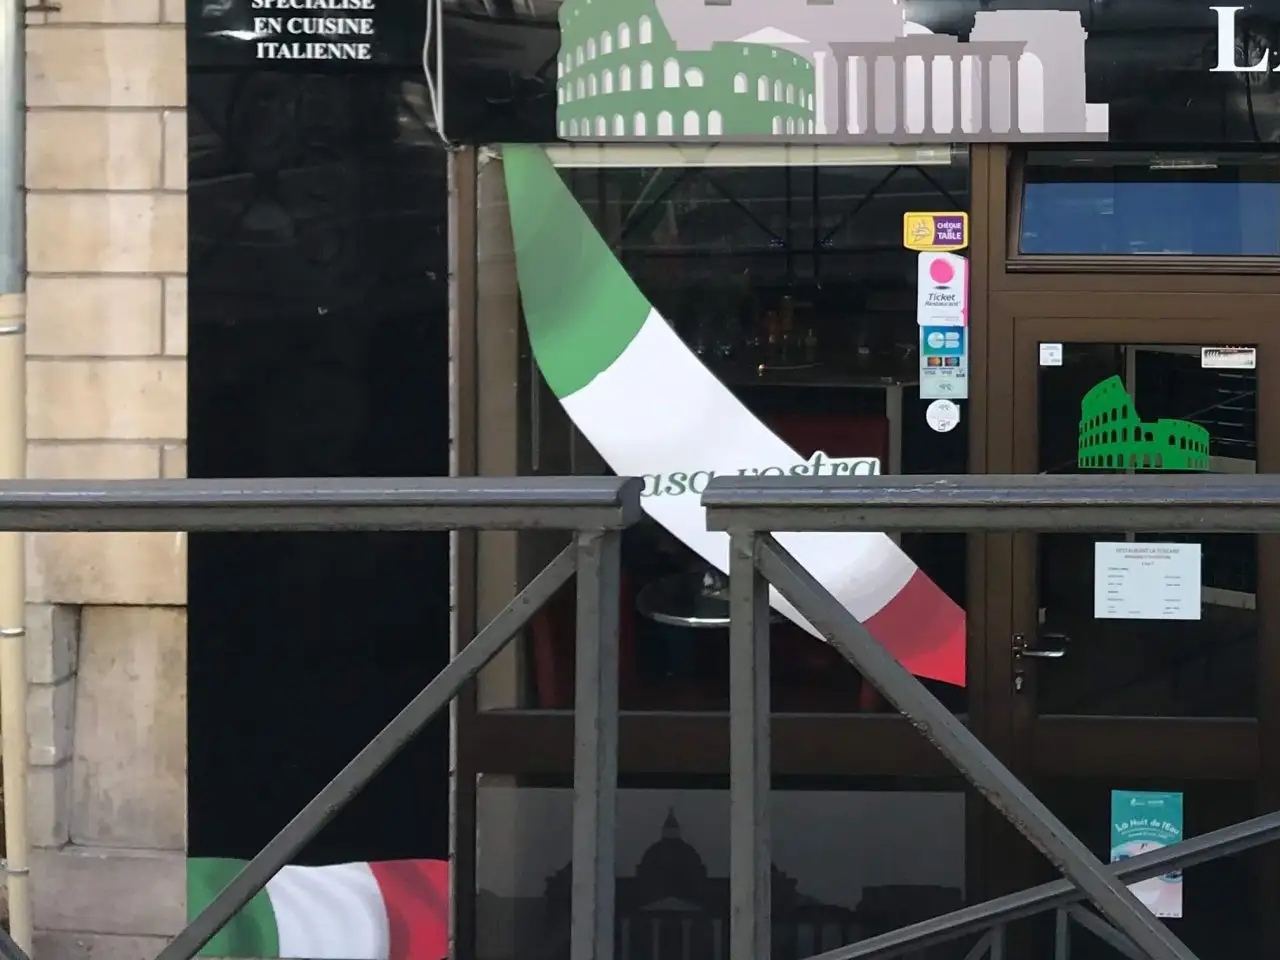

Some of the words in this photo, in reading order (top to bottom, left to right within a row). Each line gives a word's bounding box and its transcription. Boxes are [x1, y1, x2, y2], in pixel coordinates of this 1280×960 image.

[253, 17, 282, 34] EN
[286, 17, 375, 35] CUISINE
[255, 42, 373, 60] ITALIENNE
[937, 231, 962, 240] TABLE
[928, 292, 956, 302] Ticket
